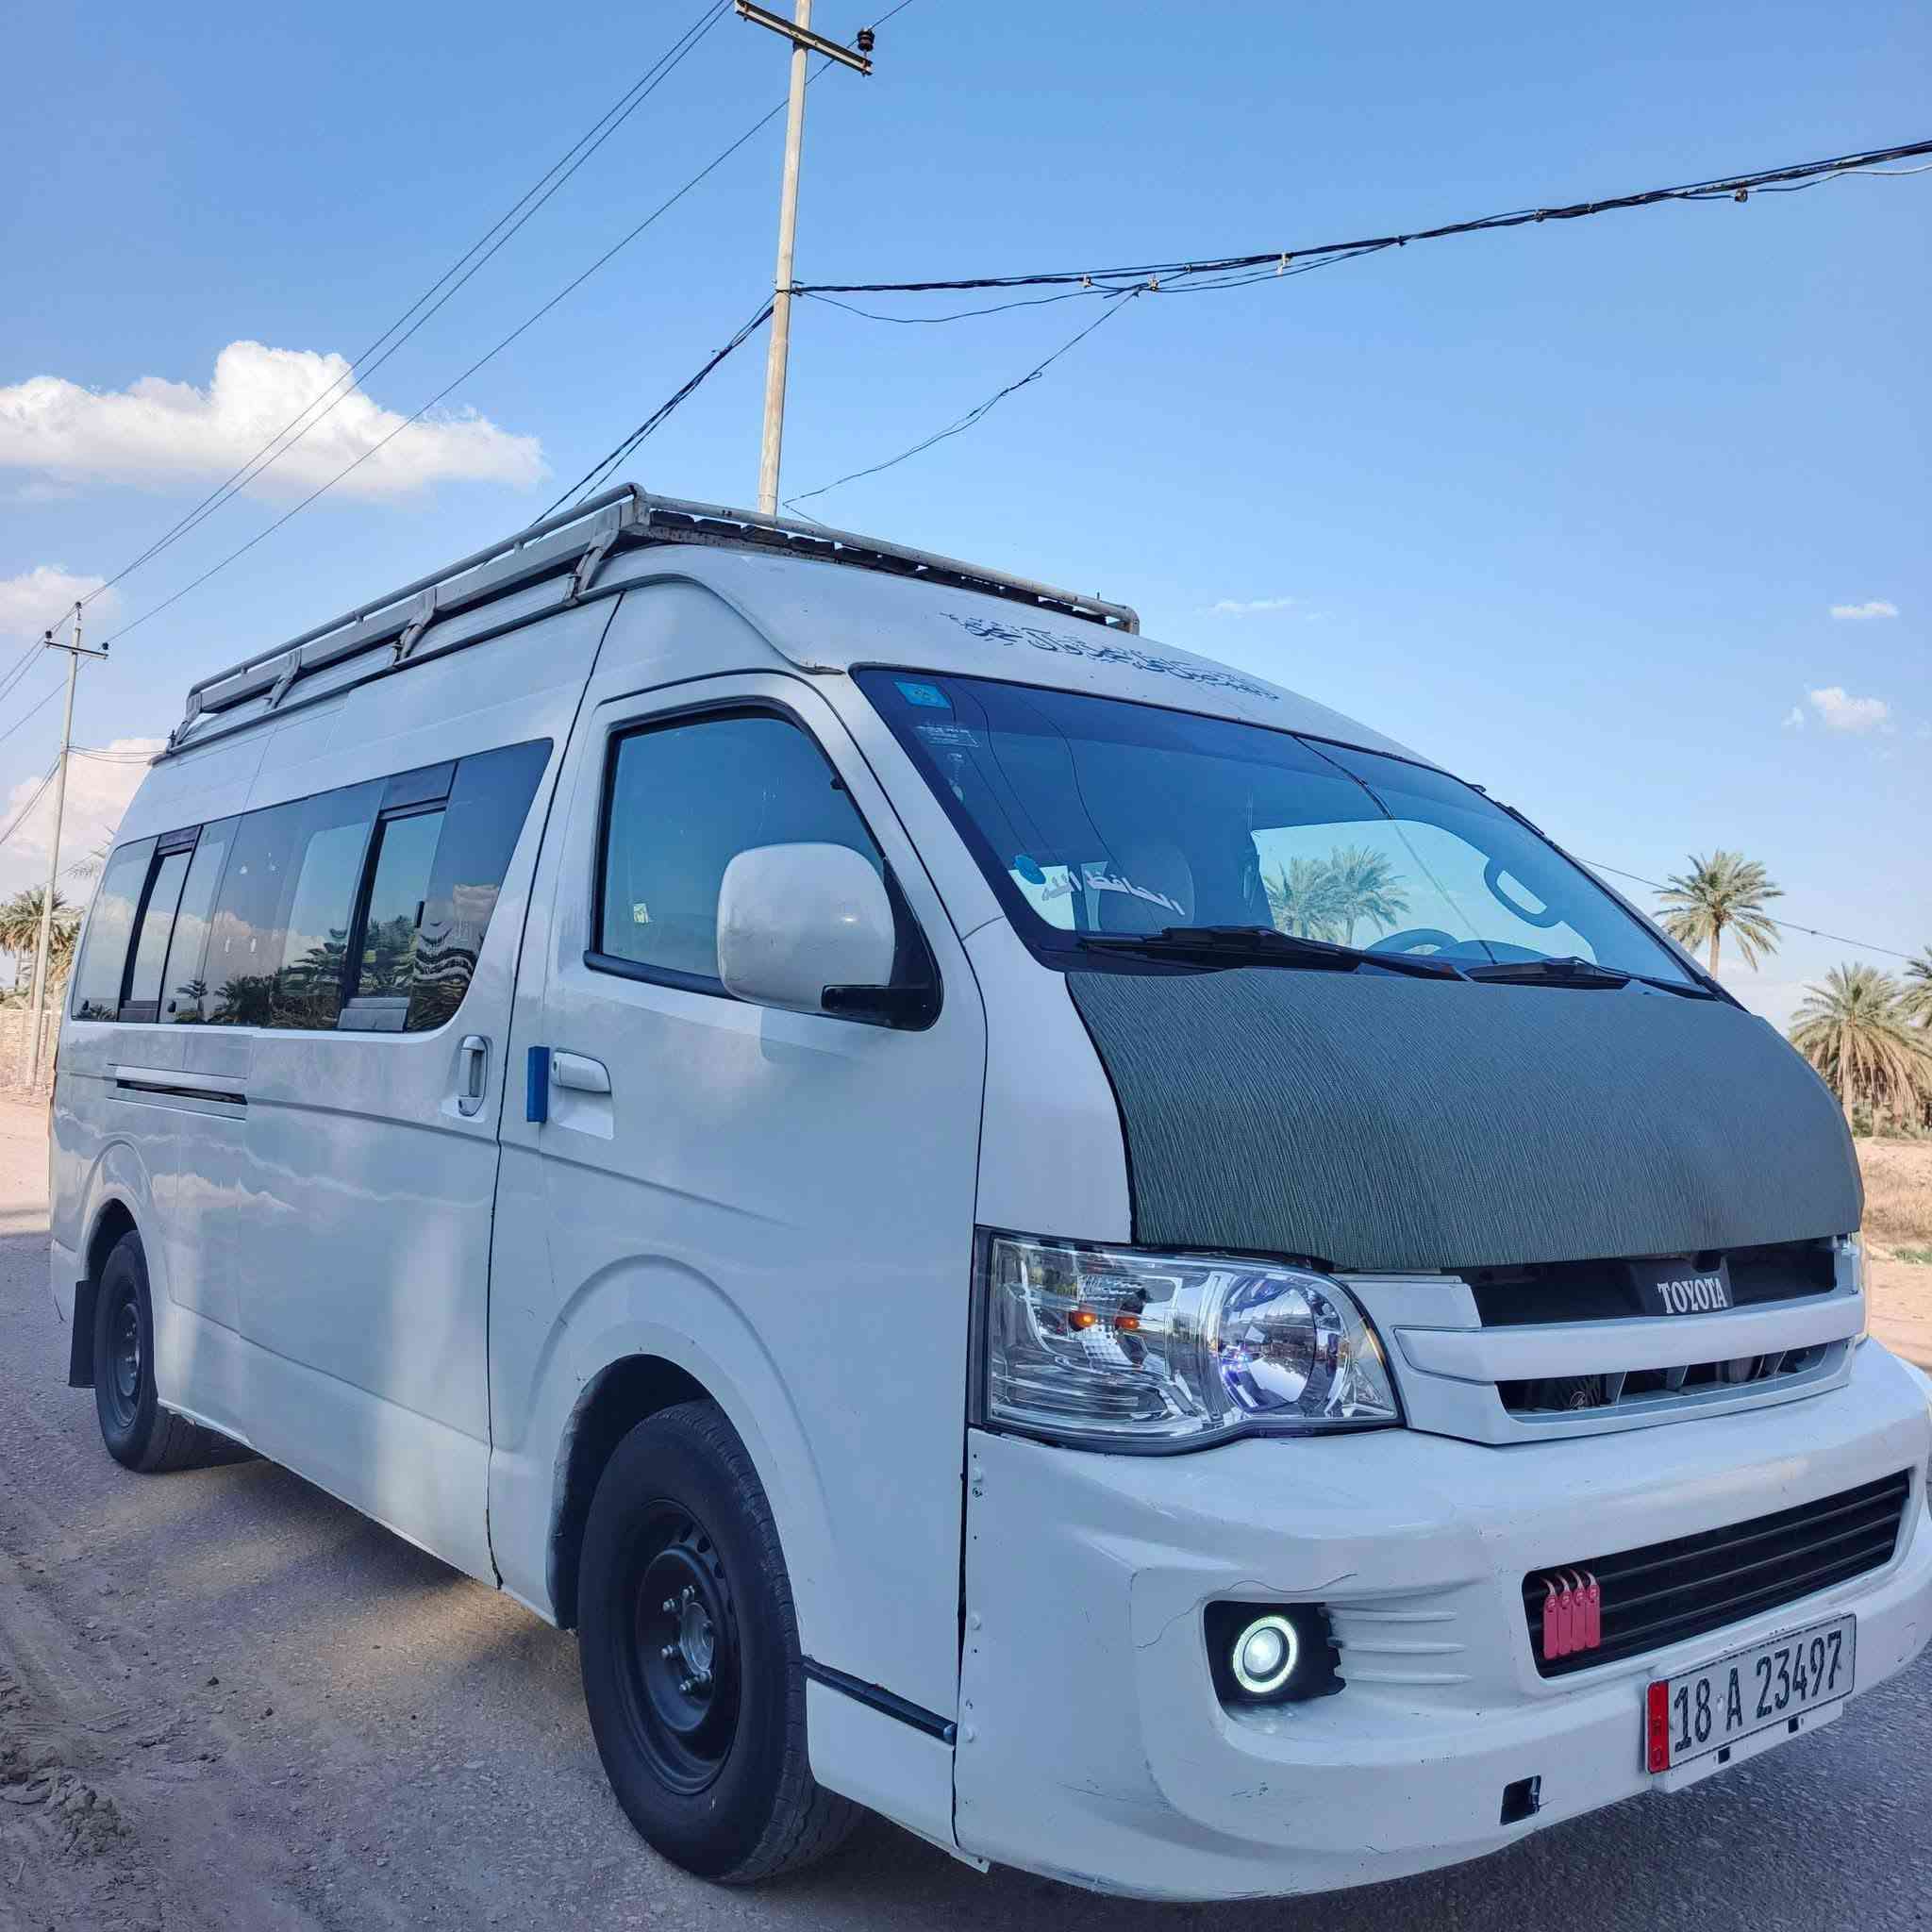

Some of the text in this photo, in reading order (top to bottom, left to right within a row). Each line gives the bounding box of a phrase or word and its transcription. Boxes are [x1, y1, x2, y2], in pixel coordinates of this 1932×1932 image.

[1041, 870, 1185, 916] الحافظ الله
[1657, 1277, 1728, 1314] TOYOTA
[1674, 1676, 1712, 1753] 18
[1725, 1666, 1743, 1732] A
[1756, 1629, 1842, 1719] 23497
